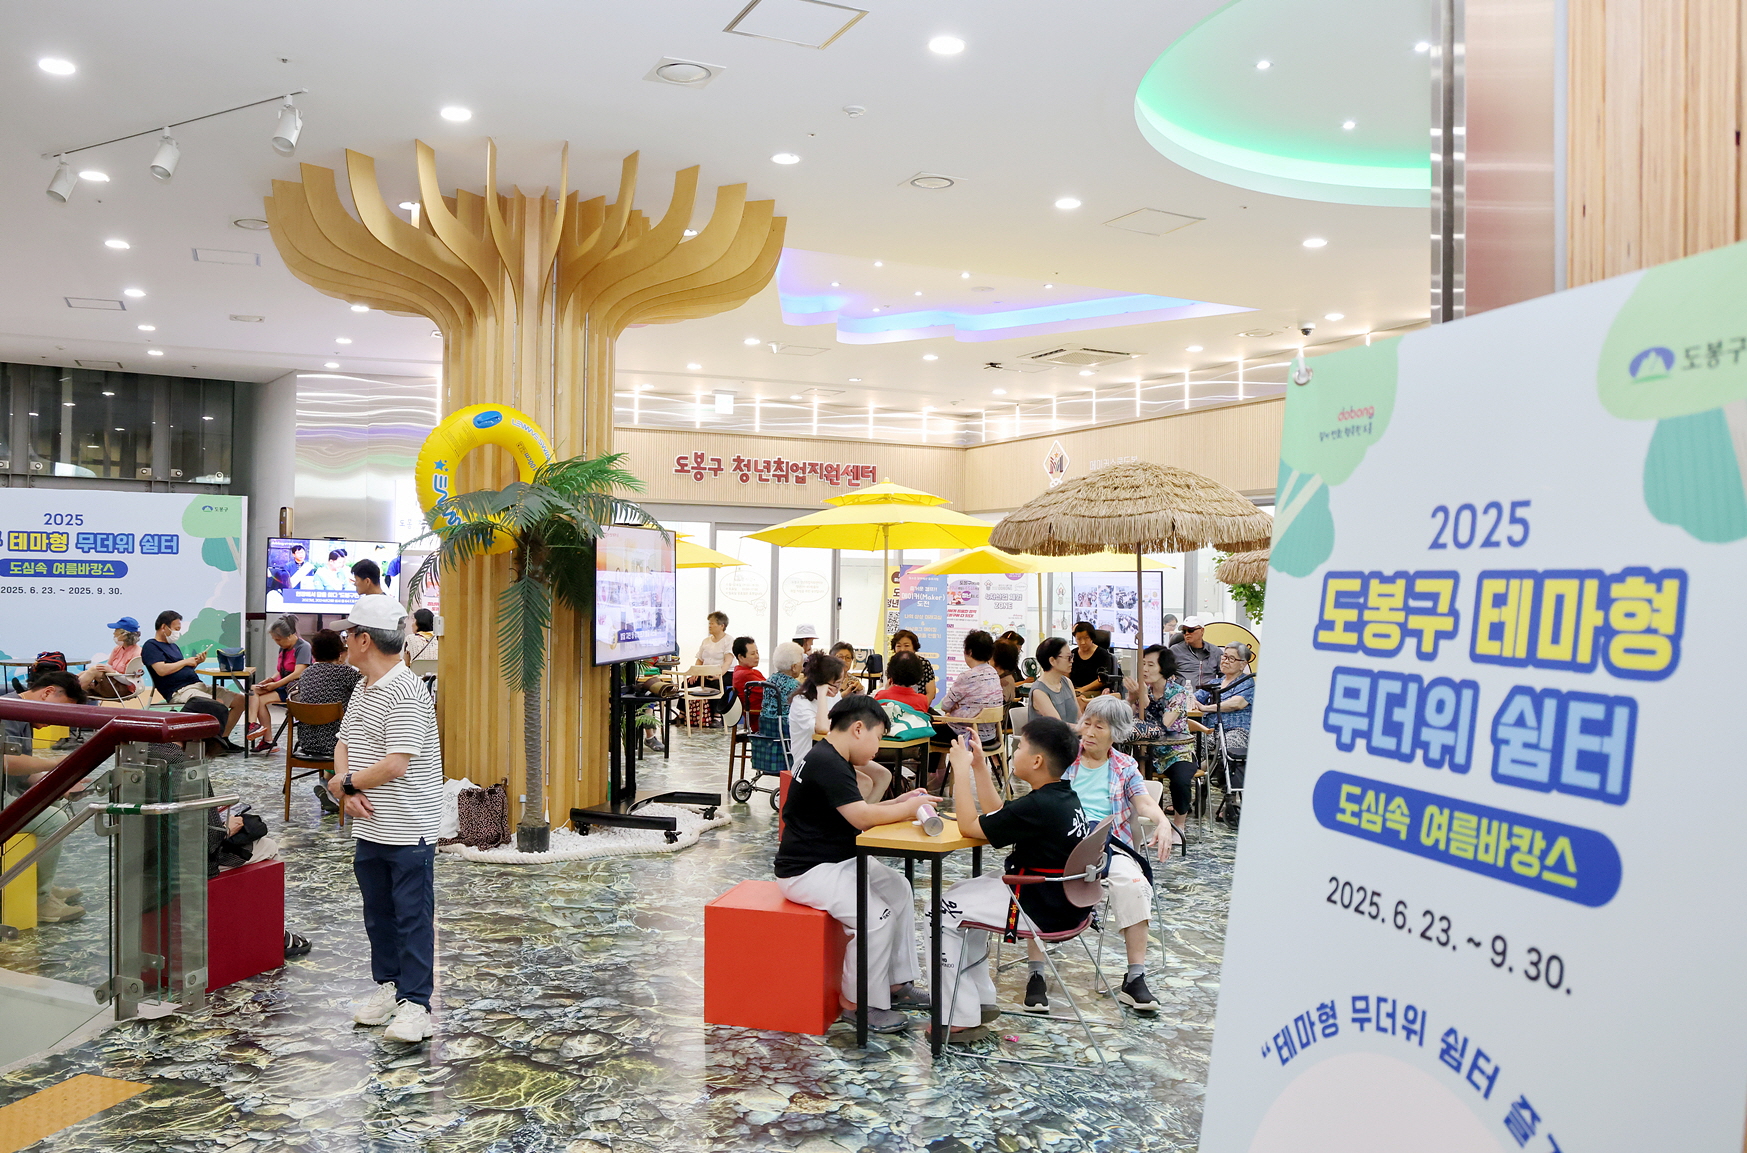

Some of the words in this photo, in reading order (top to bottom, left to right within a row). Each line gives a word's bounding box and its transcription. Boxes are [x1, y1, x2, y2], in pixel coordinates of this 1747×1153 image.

[1682, 336, 1746, 371] 도봉구
[1338, 406, 1374, 421] dobong
[673, 450, 724, 482] 도봉구
[730, 454, 877, 487] 청년취업지원센터
[43, 513, 84, 526] 2025
[1428, 500, 1532, 551] 2025
[8, 531, 69, 552] 테마형
[76, 532, 134, 554] 무더위
[140, 534, 179, 554] 쉼터
[10, 562, 48, 574] 도심속
[53, 562, 114, 575] 여름바캉스
[1312, 570, 1460, 662] 도봉구
[1470, 566, 1690, 682] 테마형
[1323, 666, 1480, 774] 무더위
[1490, 684, 1638, 806] 쉼터
[1336, 784, 1410, 840] 도심속
[1420, 804, 1578, 888] 여름바캉스
[1326, 876, 1386, 924] 2025.
[1393, 900, 1412, 934] 6.
[1420, 910, 1457, 952] 23.
[1466, 936, 1482, 949] ~
[1490, 934, 1514, 973] 9.
[1524, 948, 1572, 996] 30.
[1350, 995, 1427, 1047] 무더위
[1438, 1026, 1502, 1100] 쉼터
